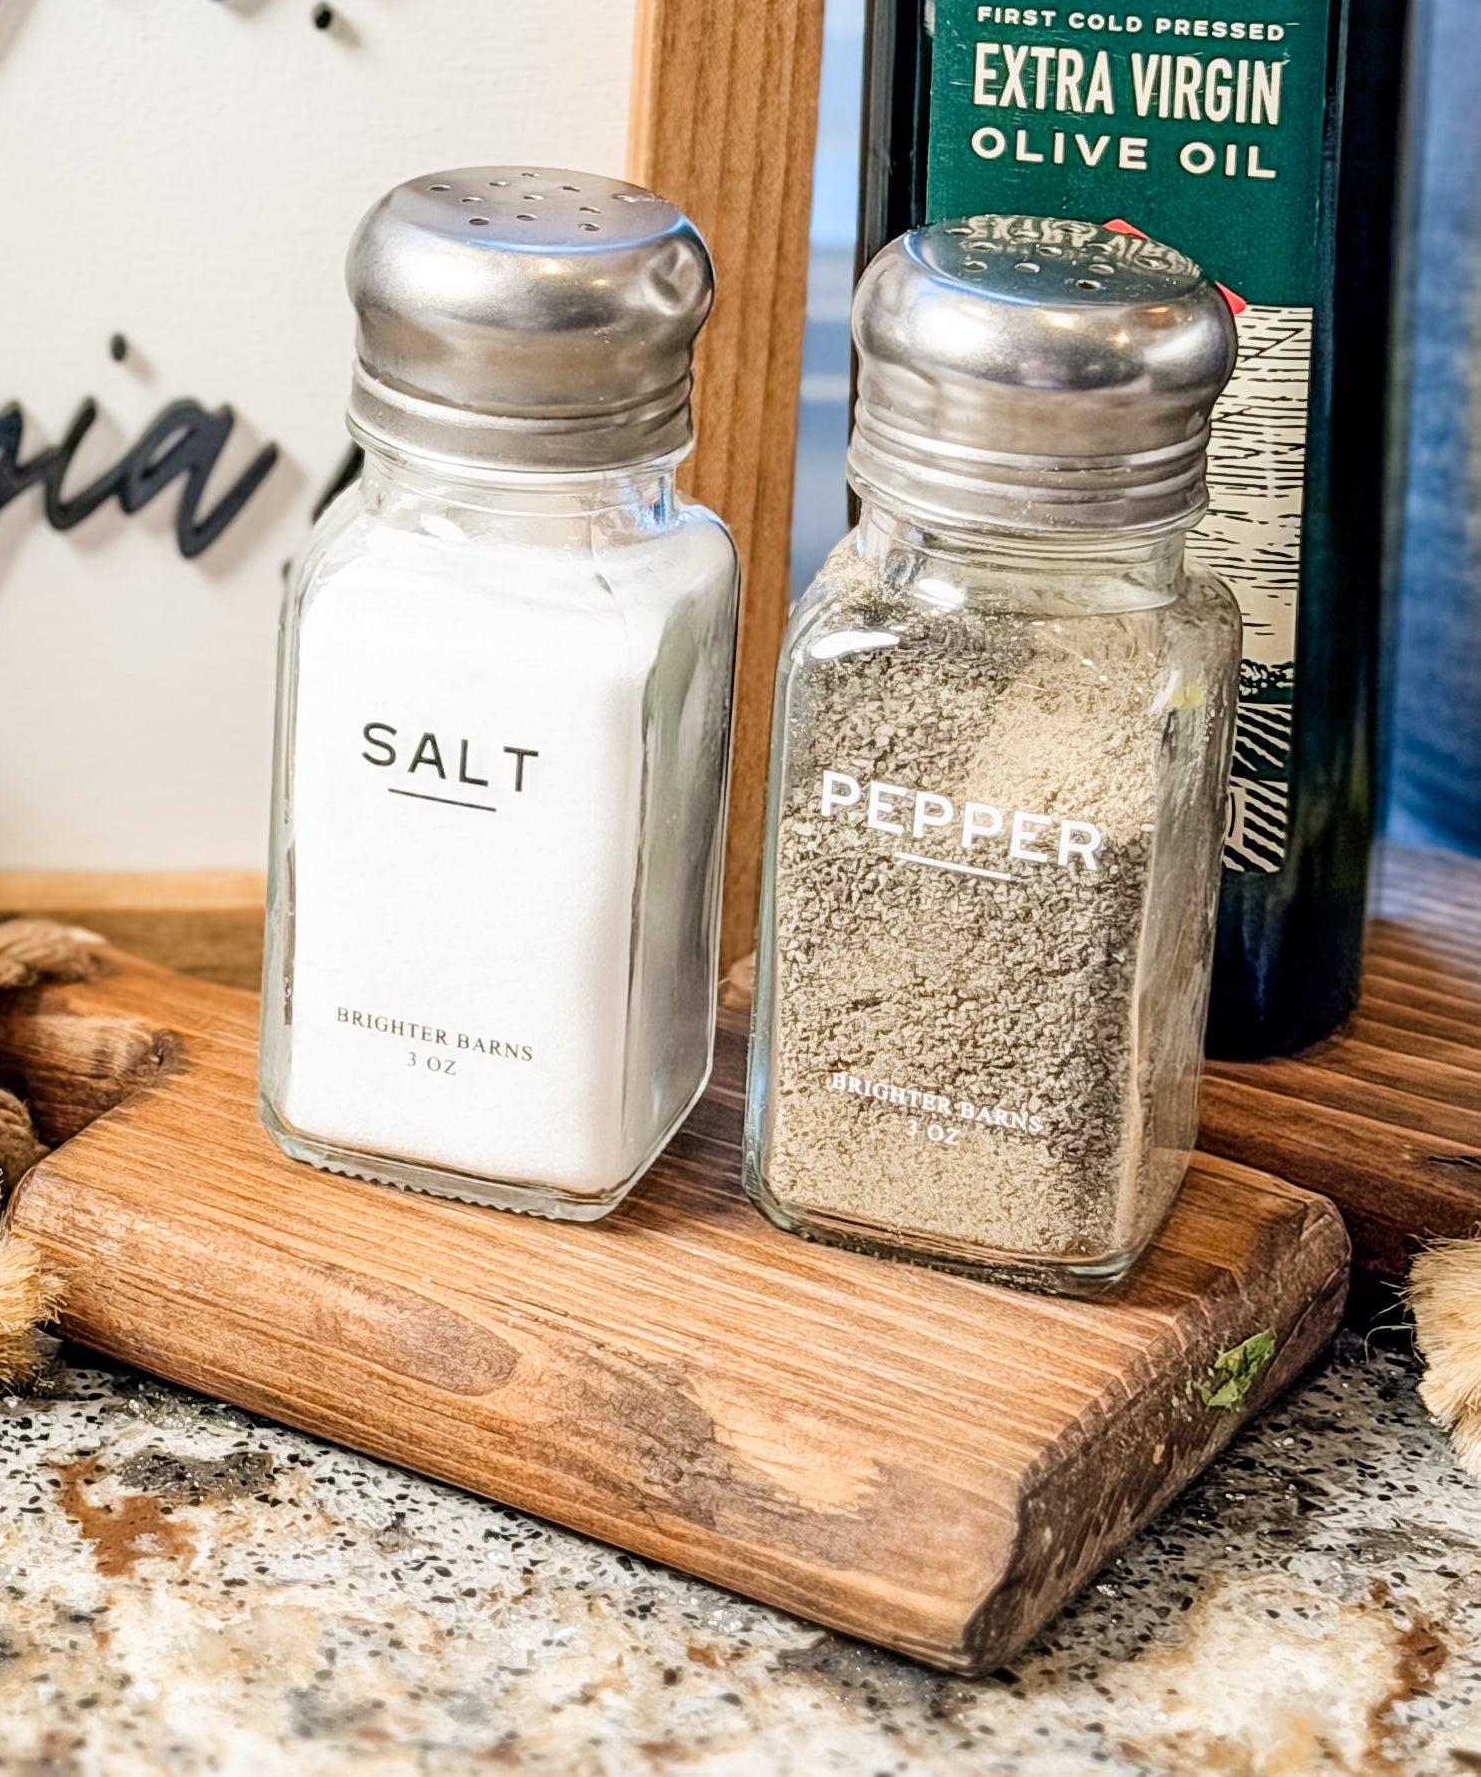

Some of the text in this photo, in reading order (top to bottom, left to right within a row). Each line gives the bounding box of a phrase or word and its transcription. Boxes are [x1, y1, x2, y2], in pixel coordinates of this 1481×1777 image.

[977, 5, 1285, 41] FIRST COLD PRESSED
[973, 42, 1283, 125] EXTRA VIRGIN
[971, 126, 1277, 179] OLIVE OIL
[361, 722, 539, 792] SALT
[821, 769, 1104, 871] PEPPER
[336, 1006, 533, 1062] BRIGHTER BARNS
[407, 1051, 457, 1076] 3 OZ
[832, 1072, 1044, 1134] BRIGHTER BARNS
[907, 1119, 961, 1146] 3 OZ
